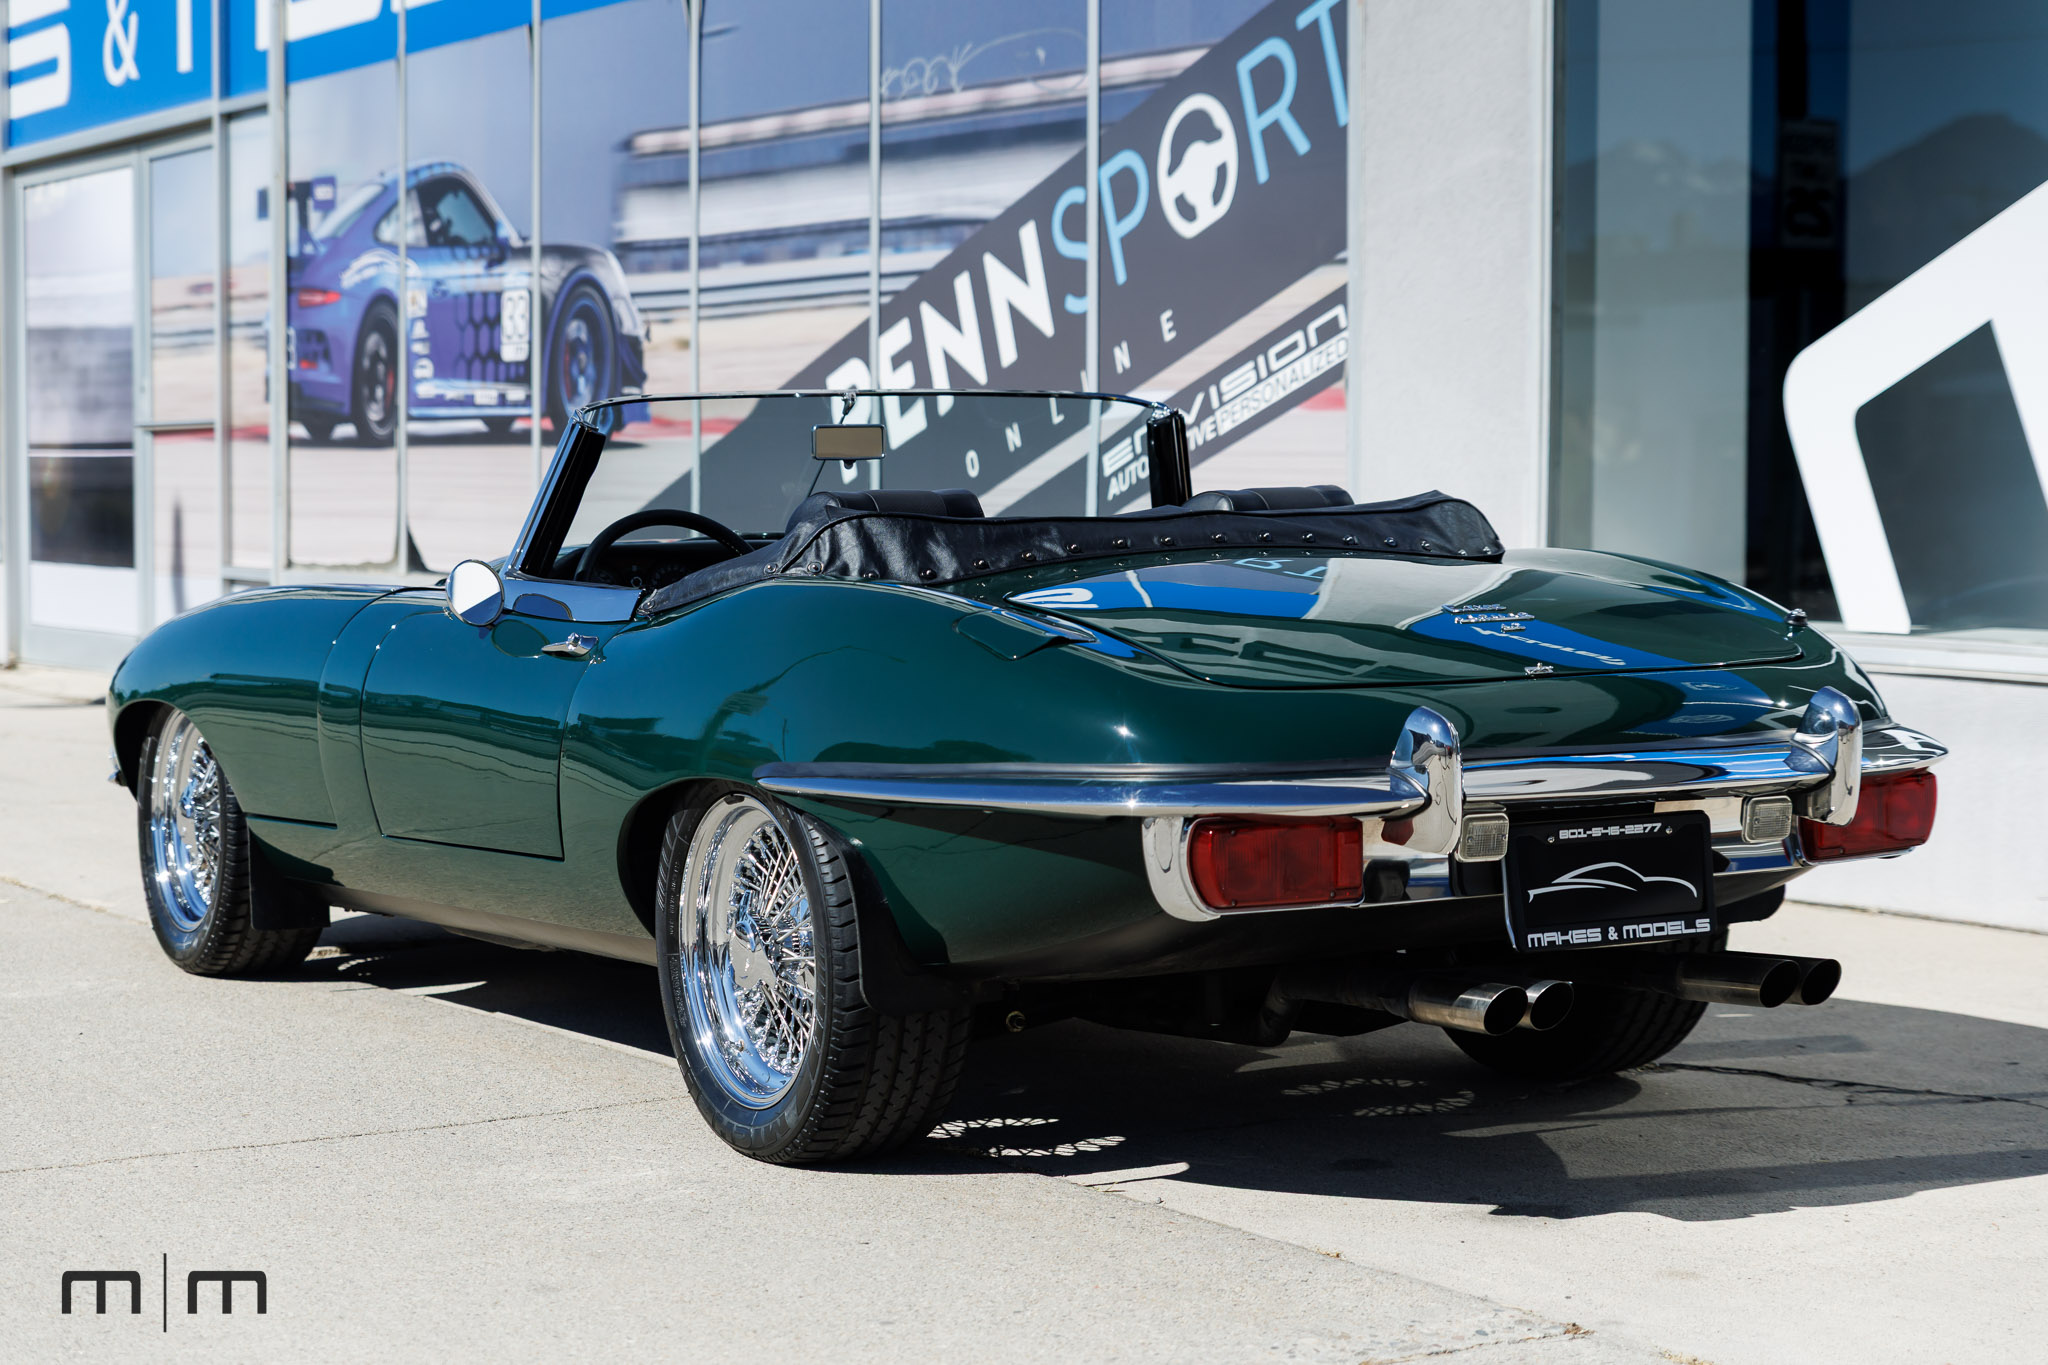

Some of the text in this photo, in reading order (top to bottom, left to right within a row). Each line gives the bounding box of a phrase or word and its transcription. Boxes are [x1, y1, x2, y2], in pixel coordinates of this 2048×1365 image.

[1527, 918, 1711, 947] MAKES & MODELS
